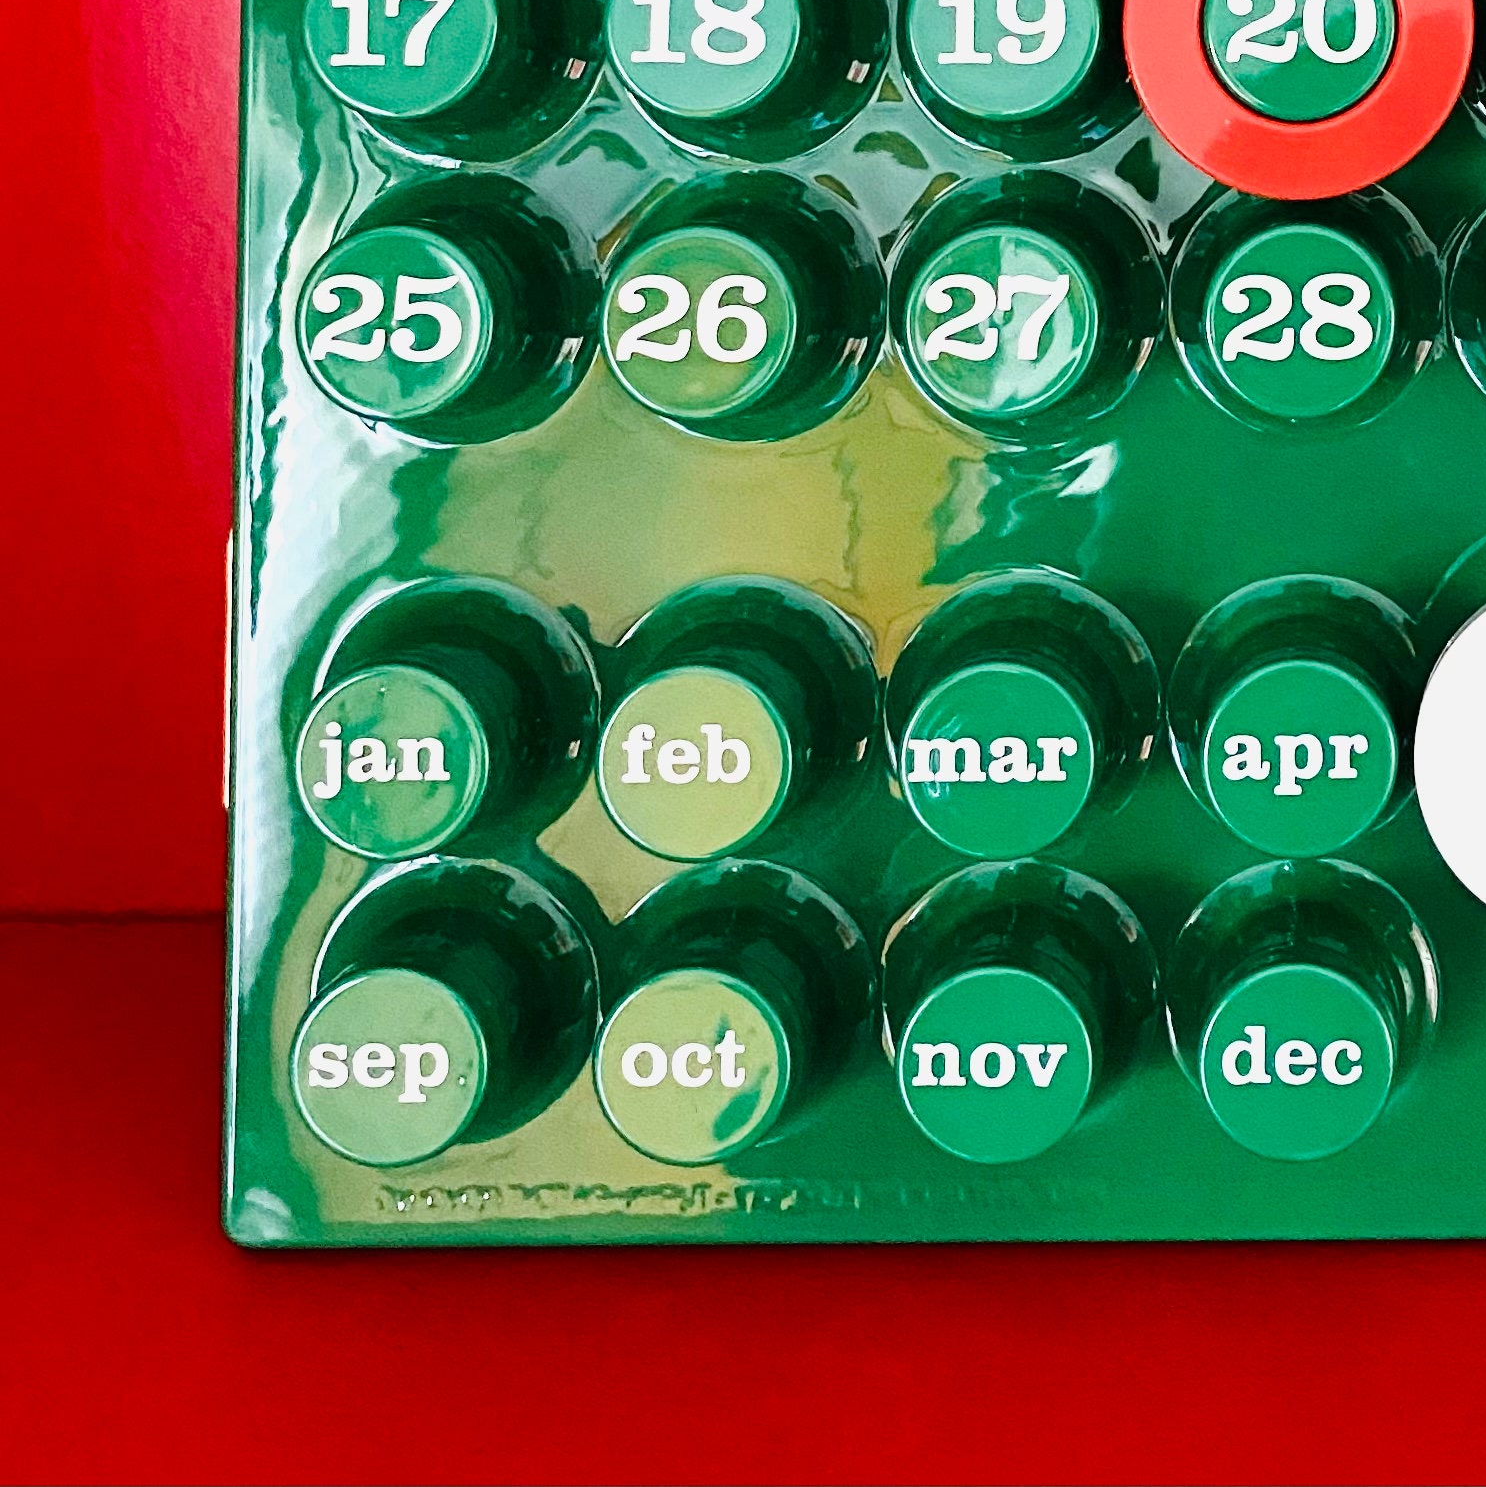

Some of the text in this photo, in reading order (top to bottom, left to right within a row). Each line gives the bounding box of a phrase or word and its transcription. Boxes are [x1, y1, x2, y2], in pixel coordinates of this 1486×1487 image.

[310, 273, 463, 363] 25
[614, 273, 768, 364] 26
[922, 273, 1071, 363] 27
[1221, 272, 1374, 363] 28
[311, 720, 451, 800] jan
[619, 722, 752, 786] feb
[906, 735, 1079, 784] mar
[1220, 729, 1369, 797] apr
[307, 1024, 1364, 1105] sep oct nov dec
